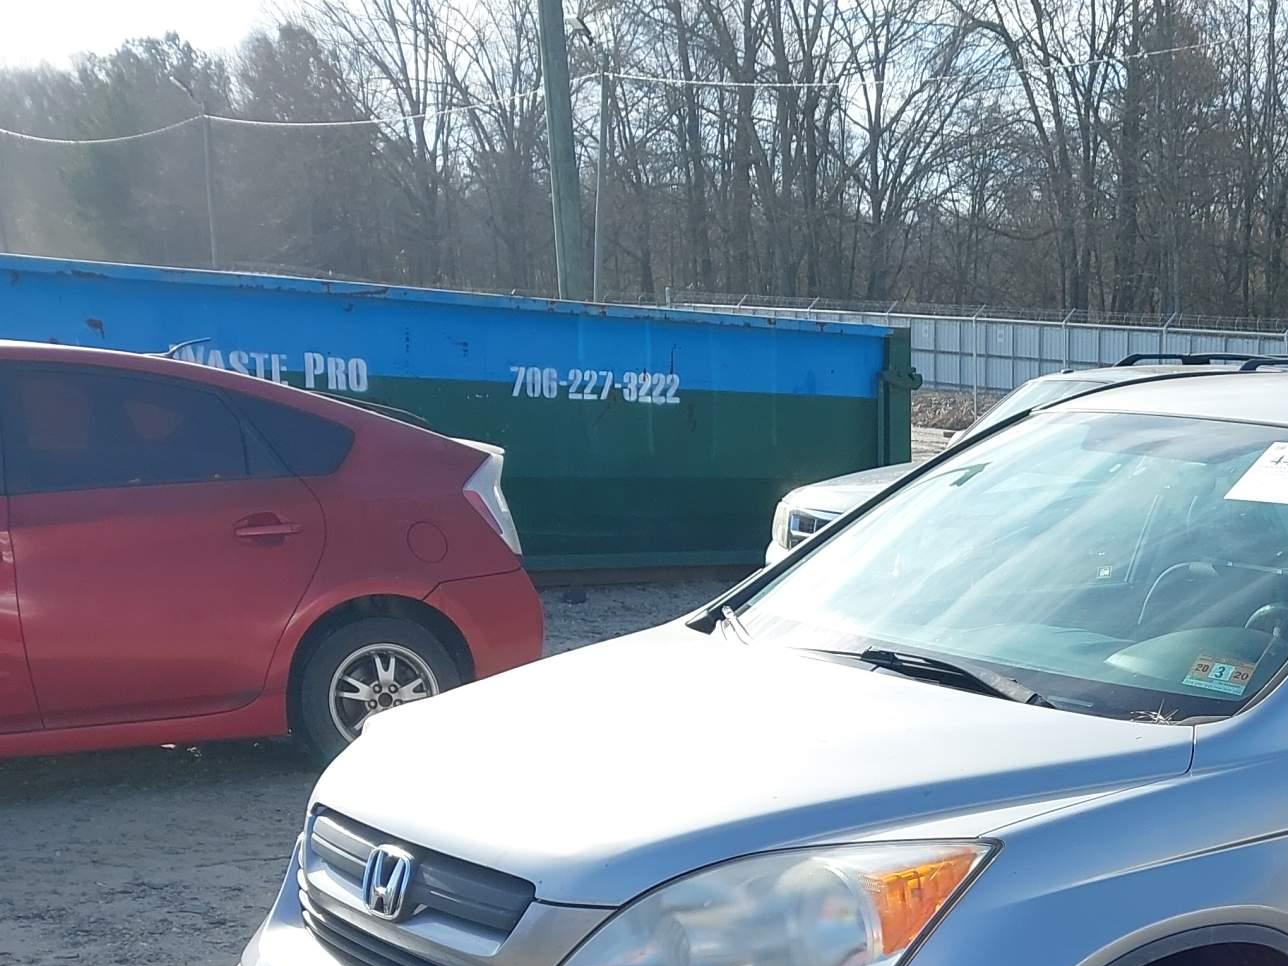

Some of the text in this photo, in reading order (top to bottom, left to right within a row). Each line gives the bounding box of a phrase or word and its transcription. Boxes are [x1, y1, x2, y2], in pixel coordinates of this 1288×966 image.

[510, 366, 681, 404] 706-227-3222
[1195, 663, 1249, 681] 20 3 20
